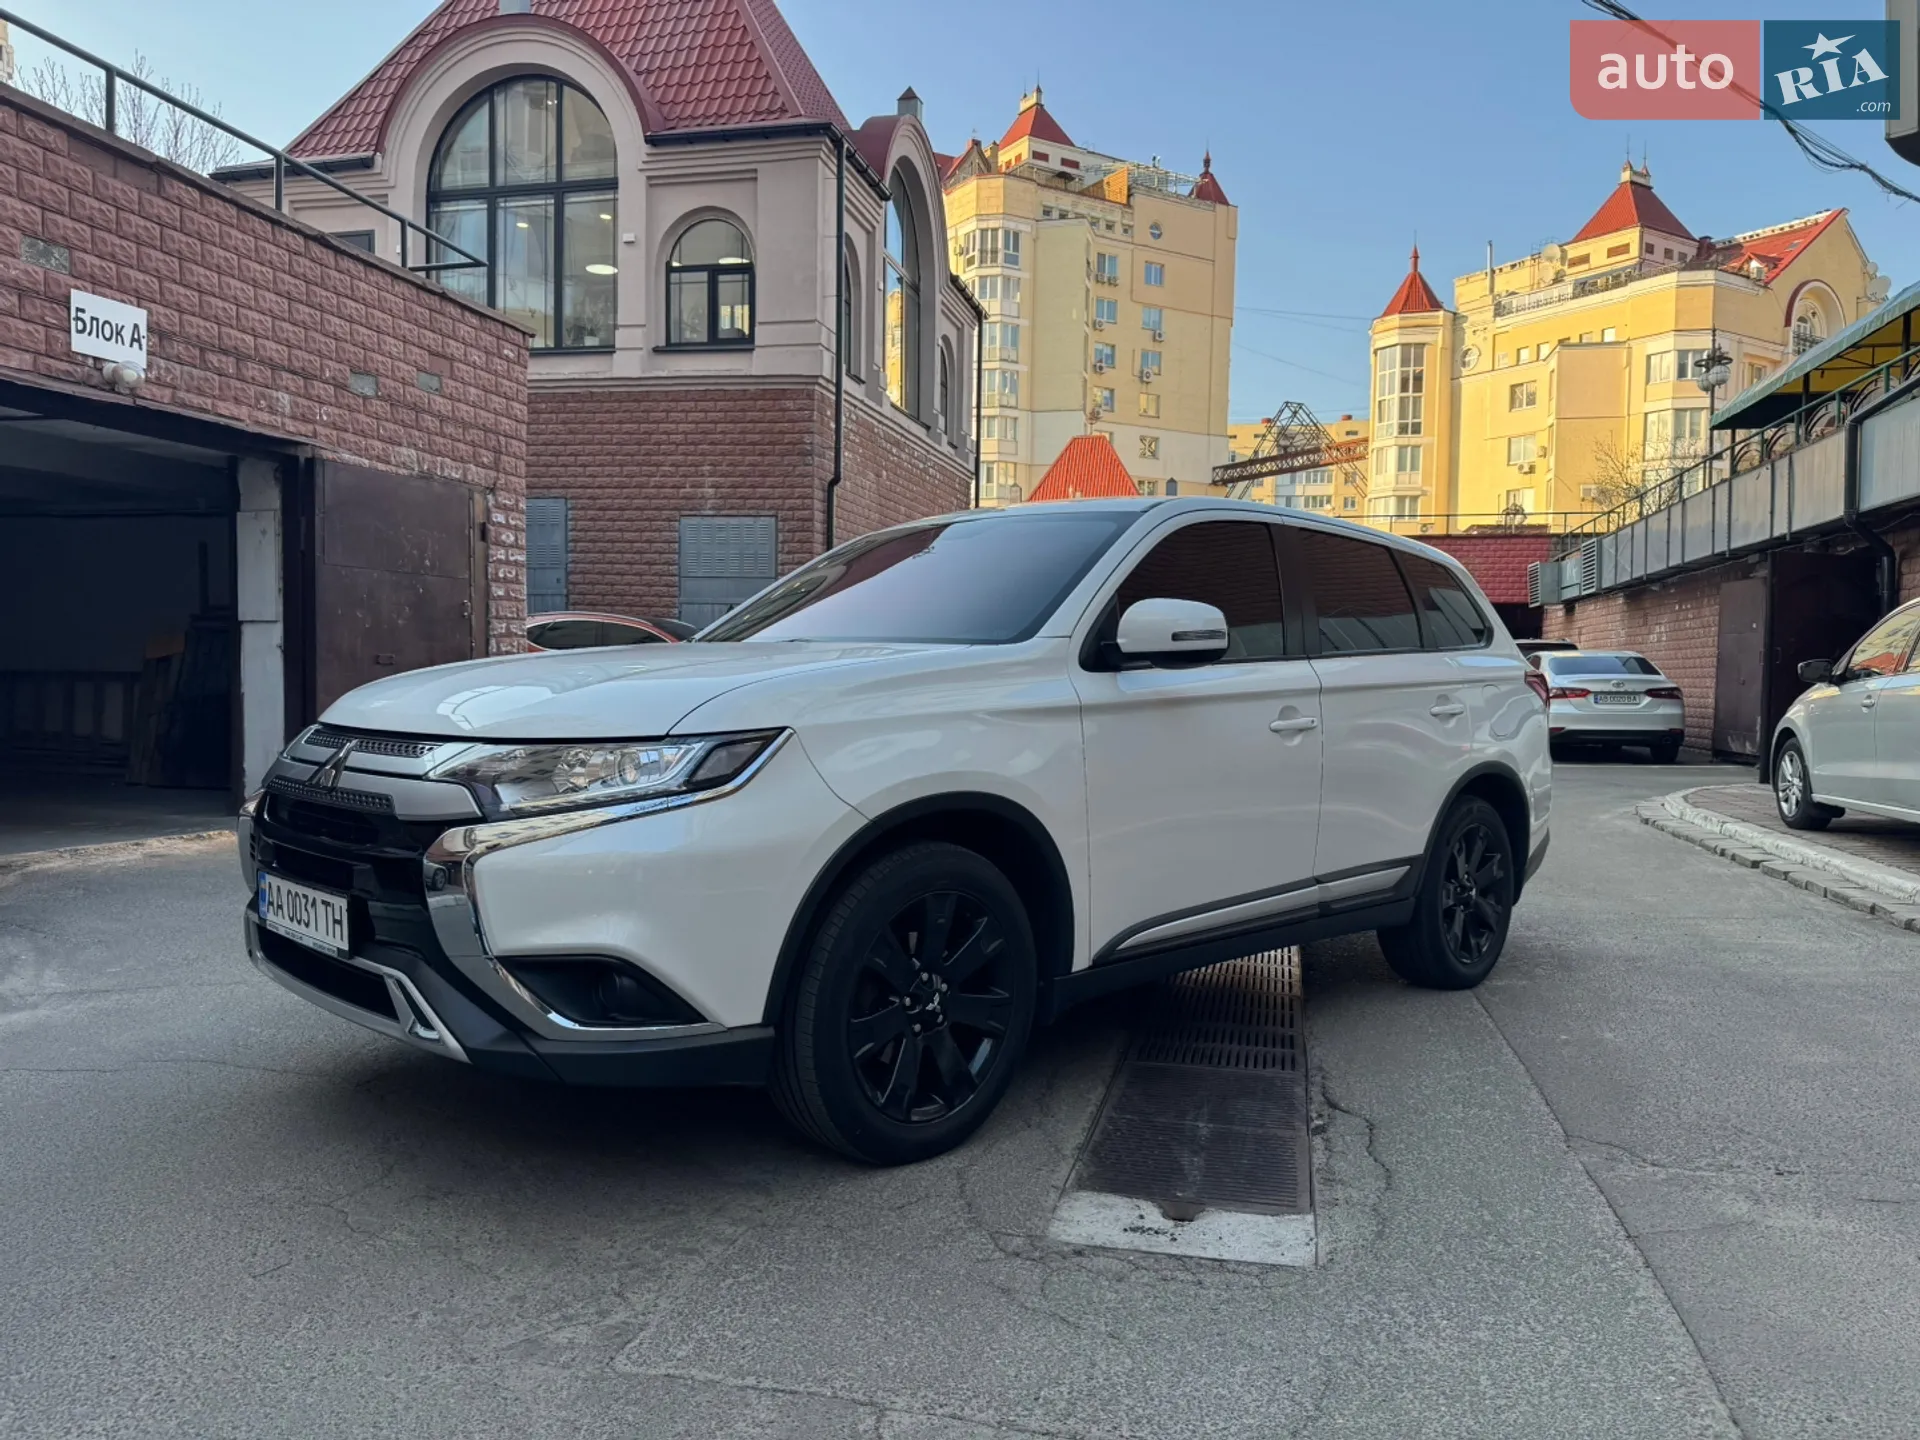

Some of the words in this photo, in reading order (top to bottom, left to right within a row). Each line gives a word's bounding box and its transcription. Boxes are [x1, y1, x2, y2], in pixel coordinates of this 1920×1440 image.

[75, 306, 126, 346] Блок
[266, 881, 285, 920] AA
[286, 888, 318, 932] 0031
[321, 899, 344, 942] TH
